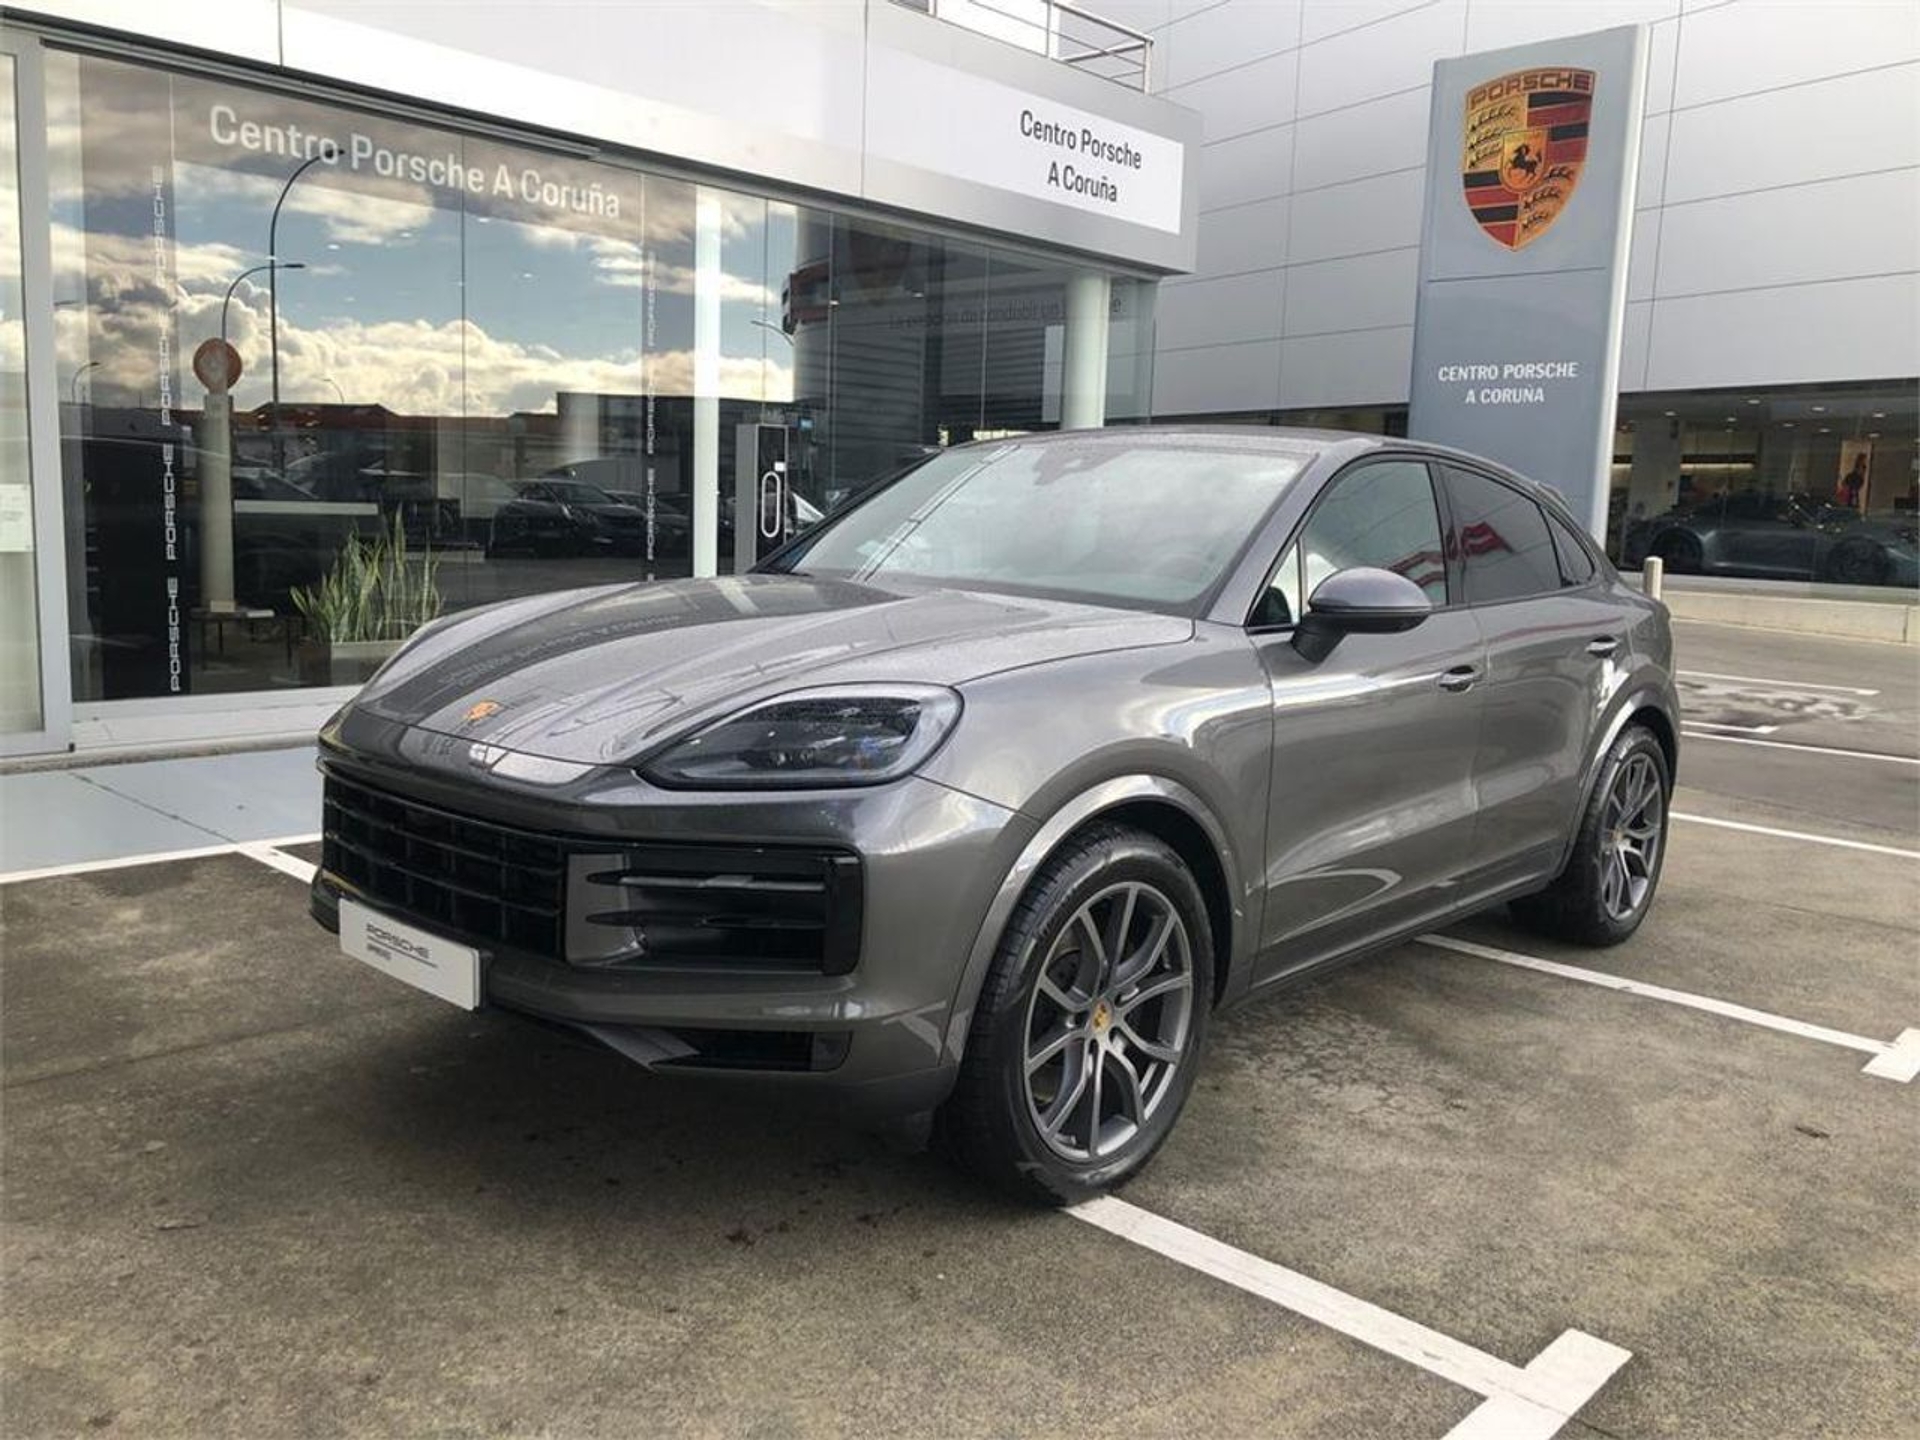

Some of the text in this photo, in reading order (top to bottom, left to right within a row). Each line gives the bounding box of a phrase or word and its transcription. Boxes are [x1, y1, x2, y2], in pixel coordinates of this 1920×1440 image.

[1470, 70, 1591, 110] PORSCHE
[209, 105, 621, 219] Centro Porsche A Coruña
[1020, 109, 1142, 170] Centro Porsche
[1047, 160, 1118, 203] A Coruña
[1437, 361, 1579, 382] CENTRO PORSCHE
[1465, 384, 1545, 404] A CORUÑA
[163, 443, 176, 560] PORSCHE
[167, 577, 181, 692] PORSCHE
